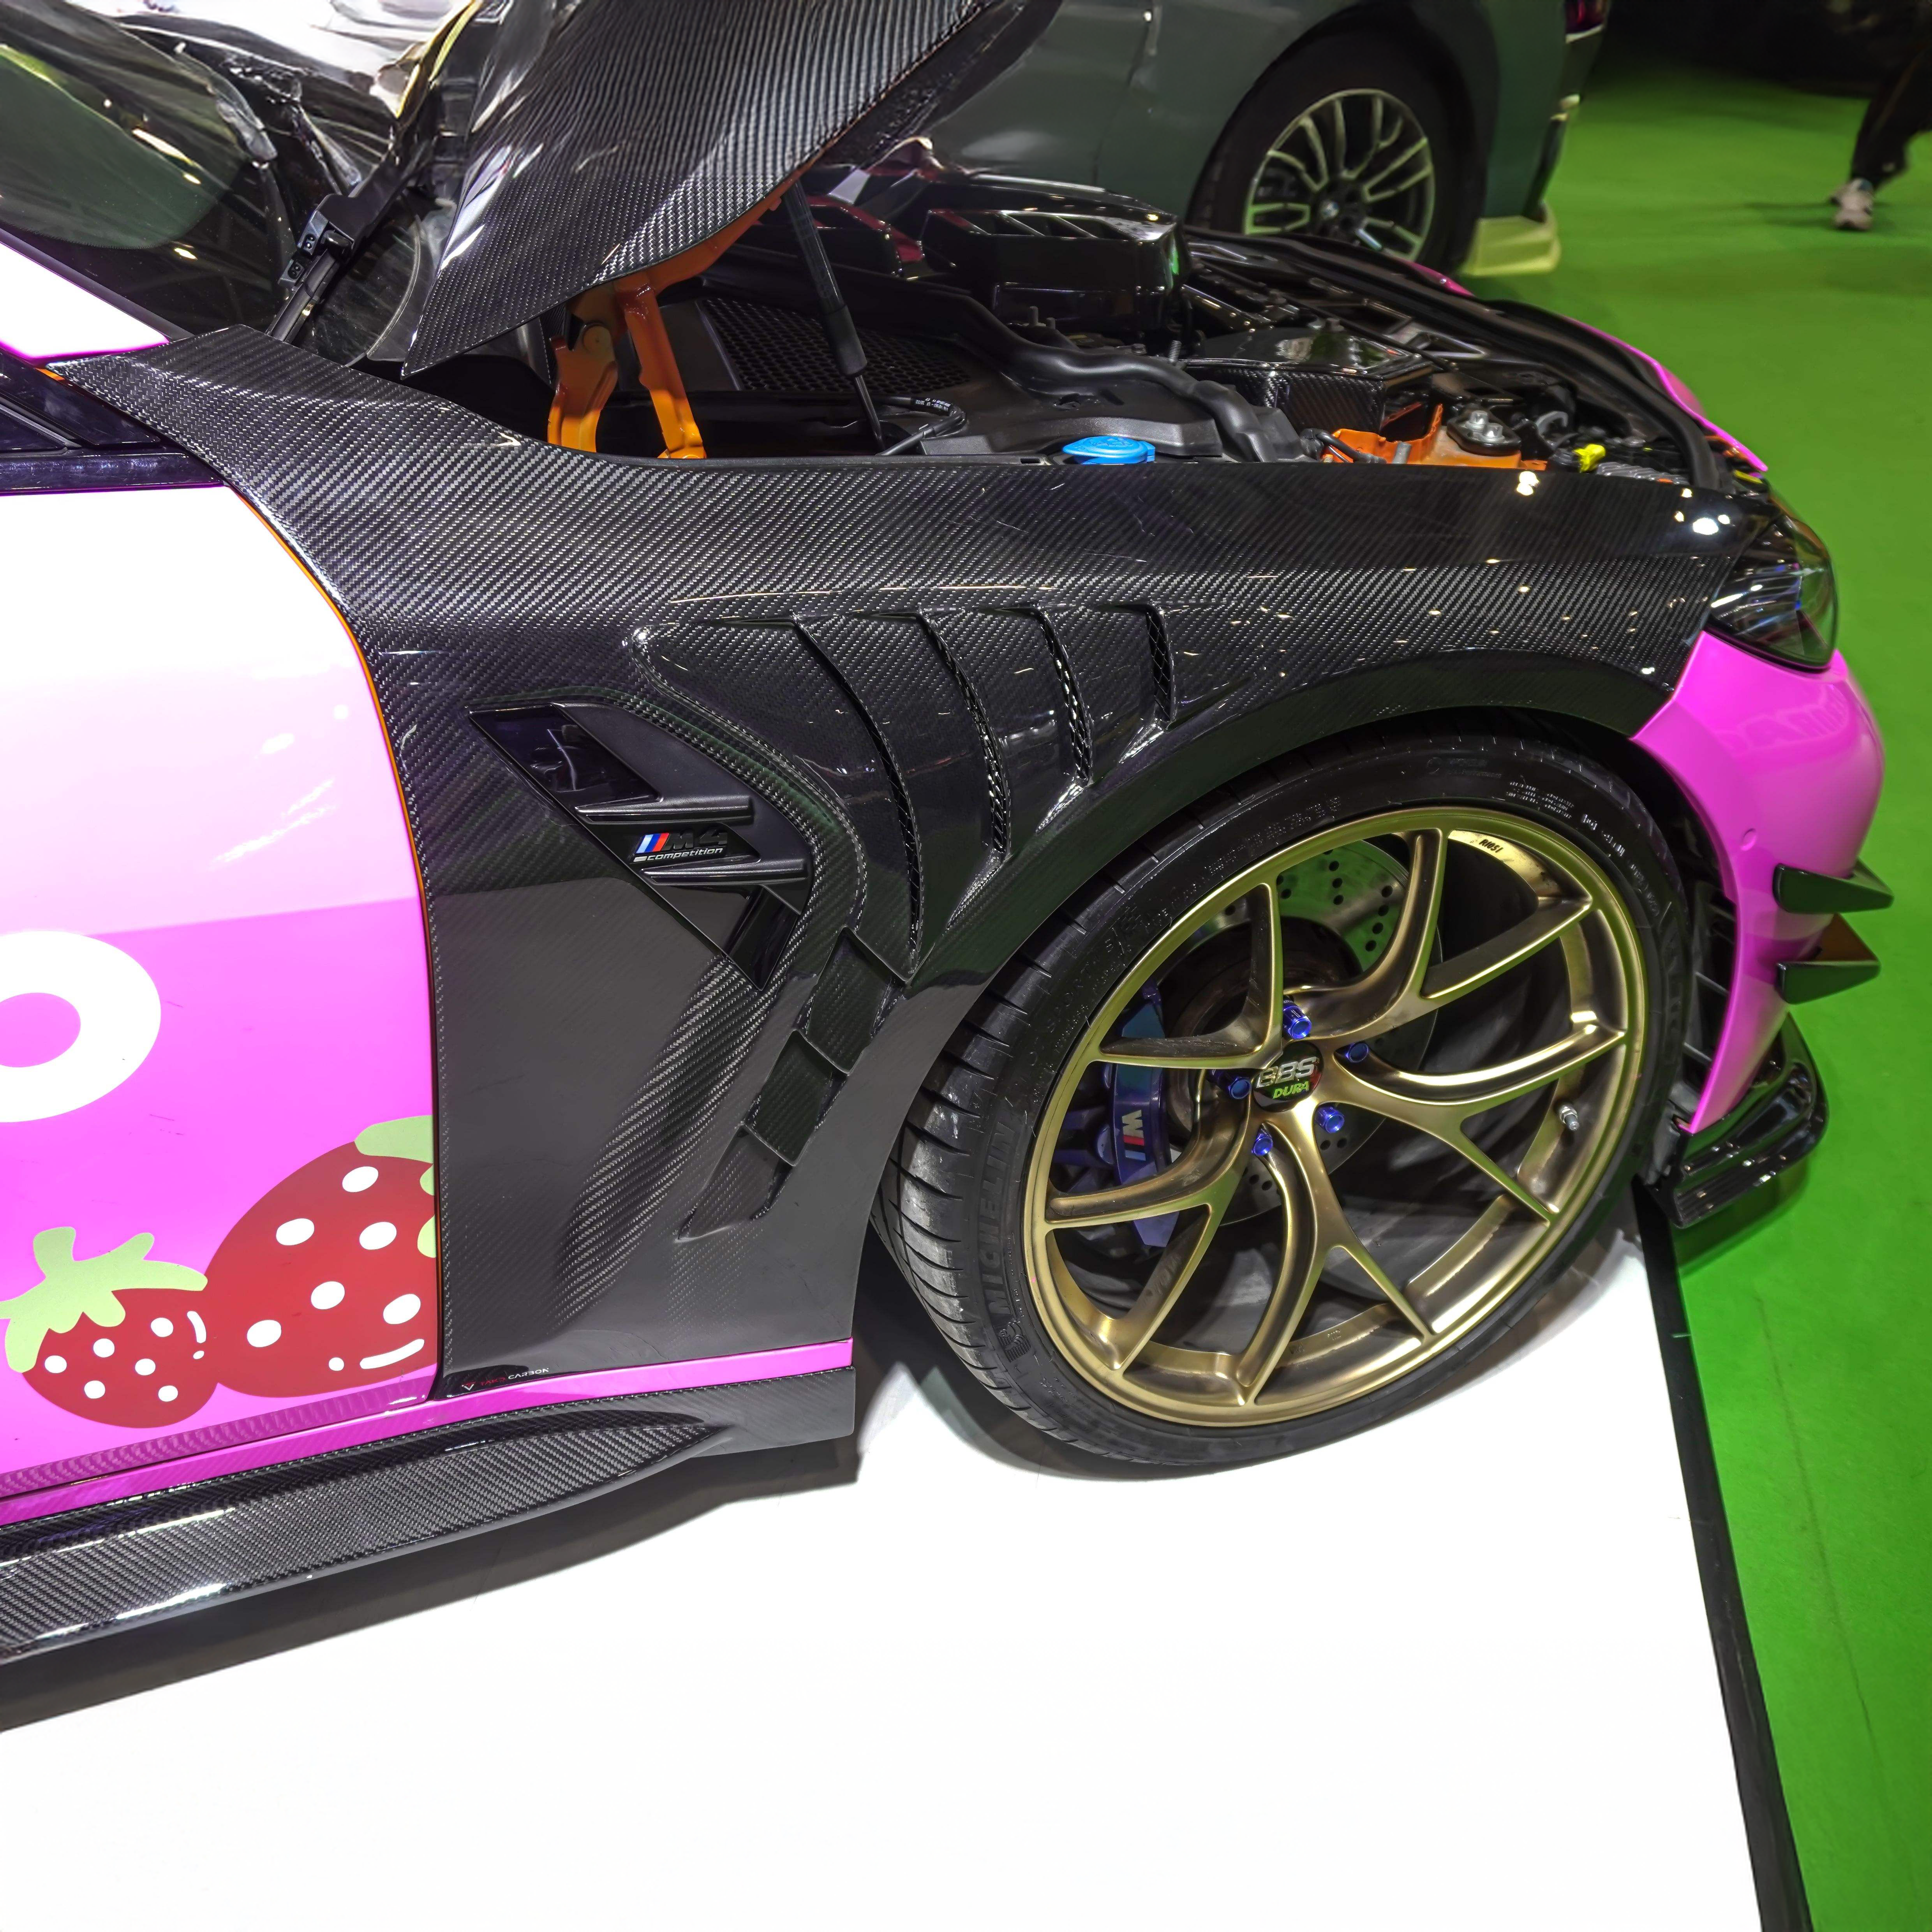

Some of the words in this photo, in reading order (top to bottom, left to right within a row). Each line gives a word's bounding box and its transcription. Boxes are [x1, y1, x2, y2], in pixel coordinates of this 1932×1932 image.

[661, 830, 728, 851] M4
[647, 848, 724, 861] competition
[1256, 1056, 1318, 1089] BBS
[1273, 1081, 1310, 1099] DURA
[978, 1122, 1016, 1314] MICHELIN
[508, 1367, 549, 1380] CARBON
